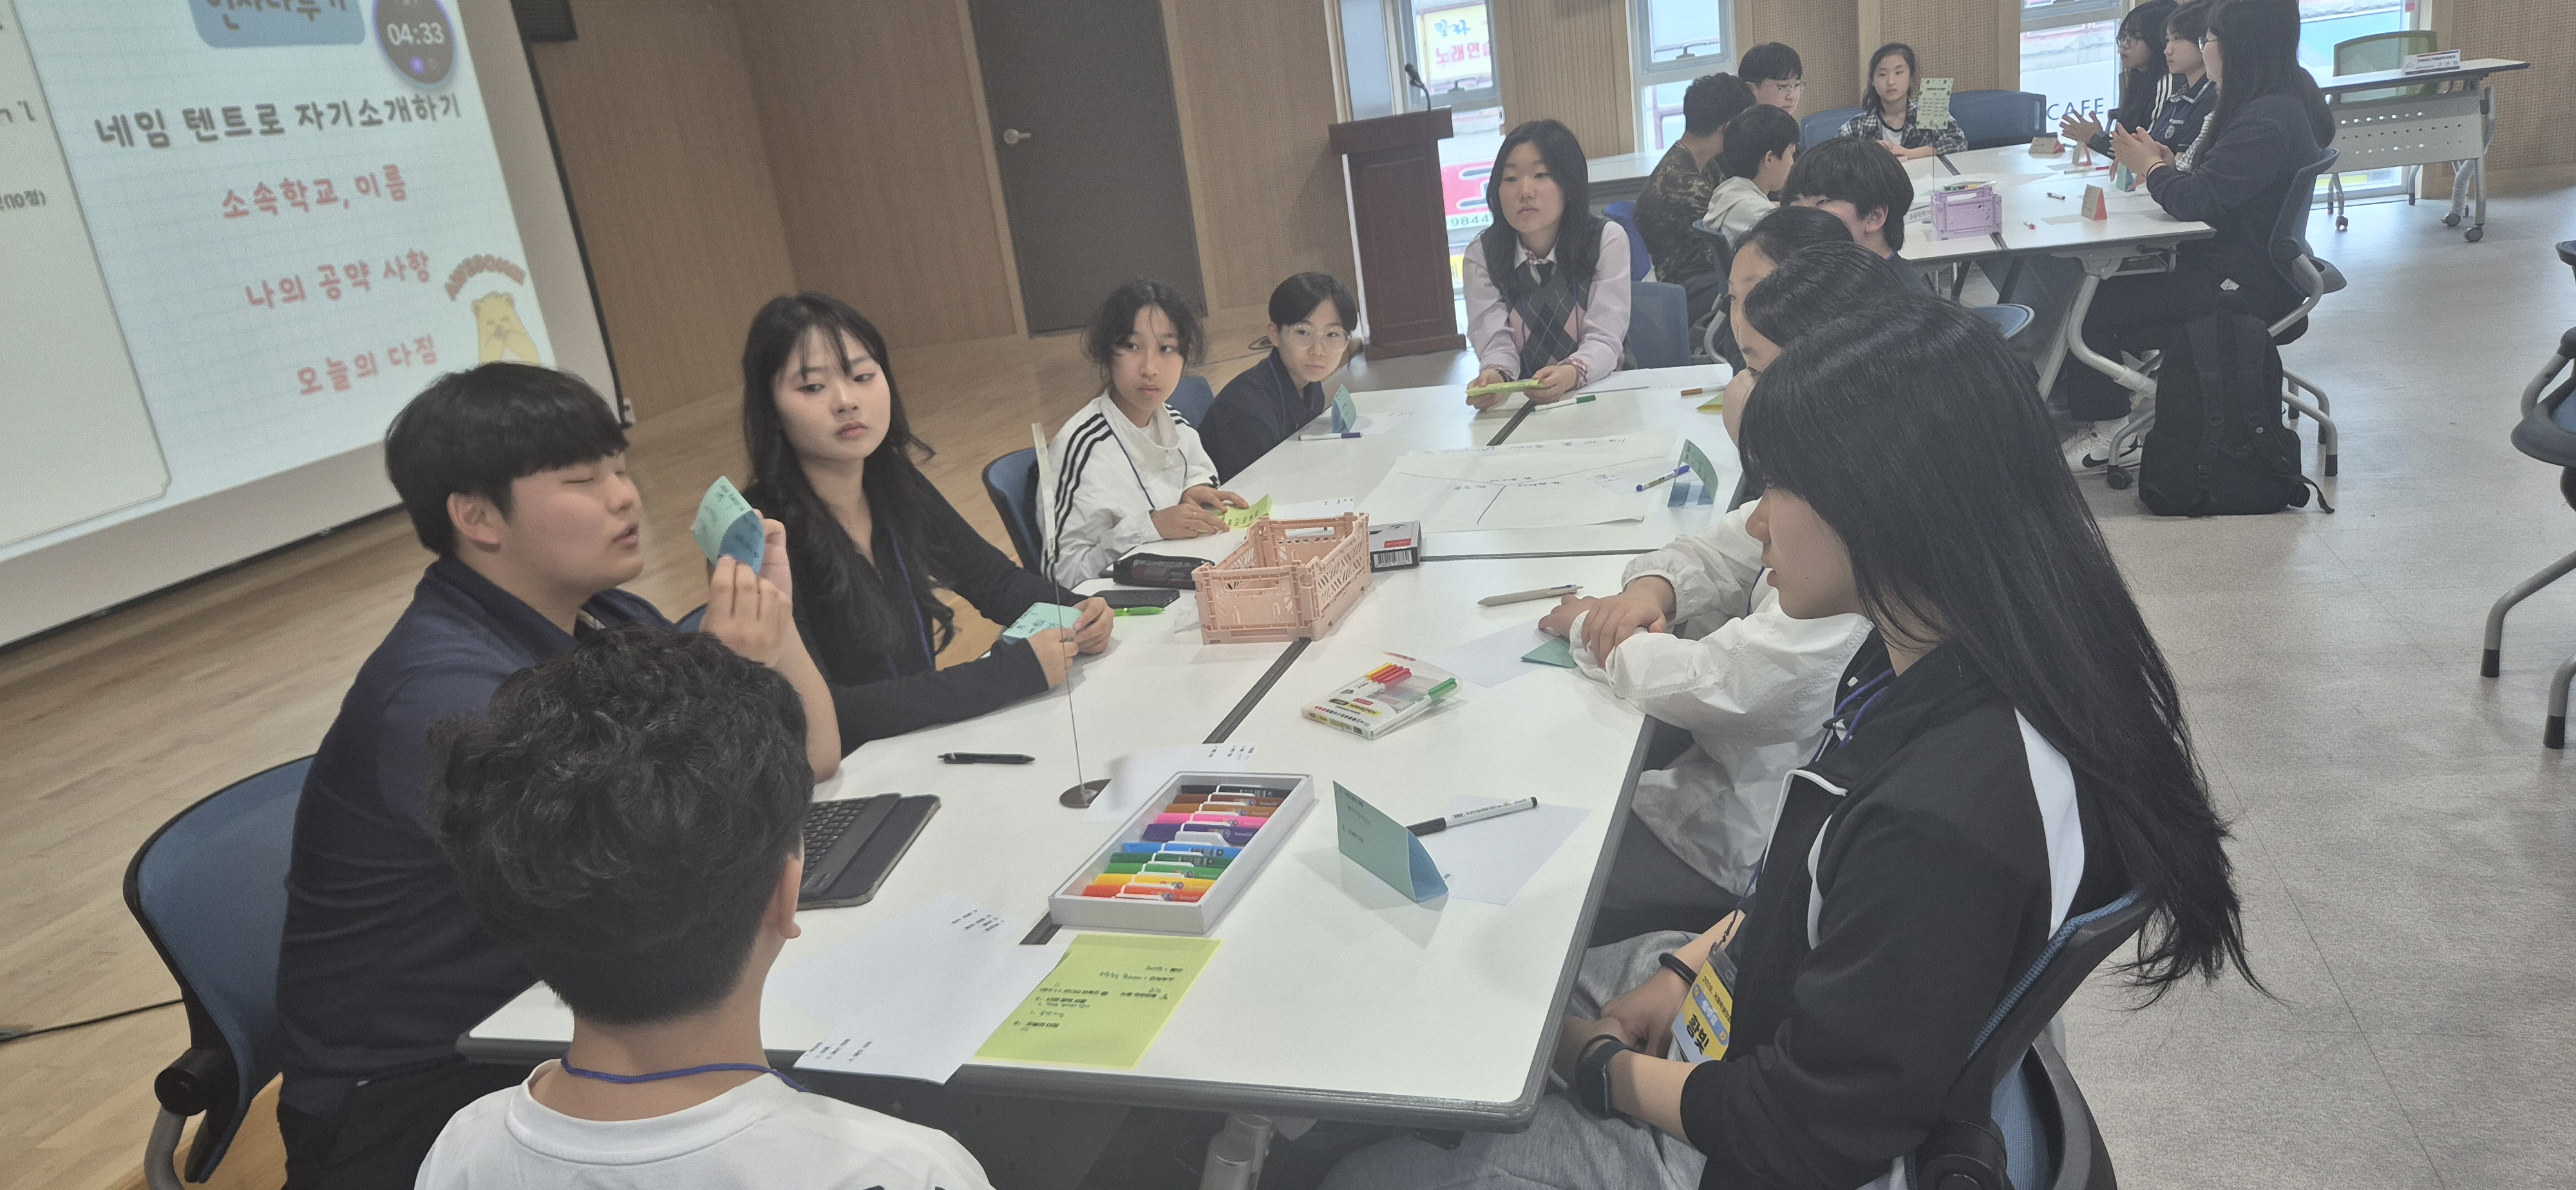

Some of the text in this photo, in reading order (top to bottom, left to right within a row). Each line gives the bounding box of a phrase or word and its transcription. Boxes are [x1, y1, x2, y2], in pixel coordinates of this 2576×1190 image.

[388, 22, 444, 46] 04:33
[94, 93, 461, 149] 네임 텐트로 자기소개하기
[2047, 98, 2104, 120] CAFE
[0, 189, 46, 209] (10점)
[222, 164, 407, 219] 소속학교, 이름
[245, 249, 430, 308] 나의 공약 사항
[297, 334, 438, 395] 오늘의 다짐
